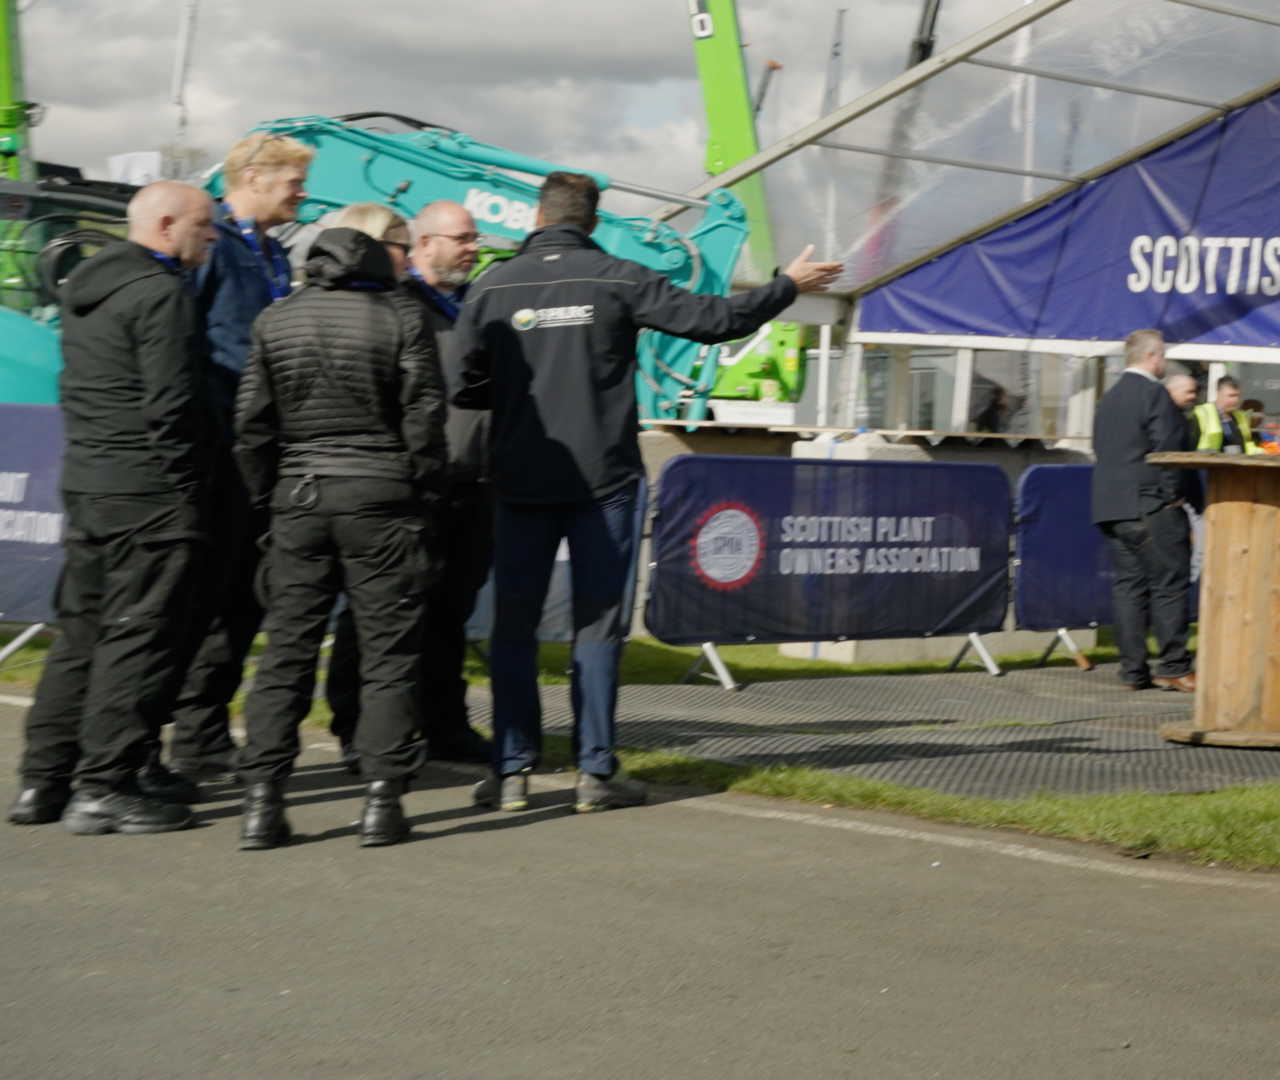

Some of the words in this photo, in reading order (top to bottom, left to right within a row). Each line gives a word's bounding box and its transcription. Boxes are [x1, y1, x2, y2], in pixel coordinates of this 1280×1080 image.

[780, 515, 872, 543] SCOTTISH
[876, 516, 935, 543] PLANT
[779, 547, 860, 575] OWNERS
[863, 546, 981, 574] ASSOCIATION
